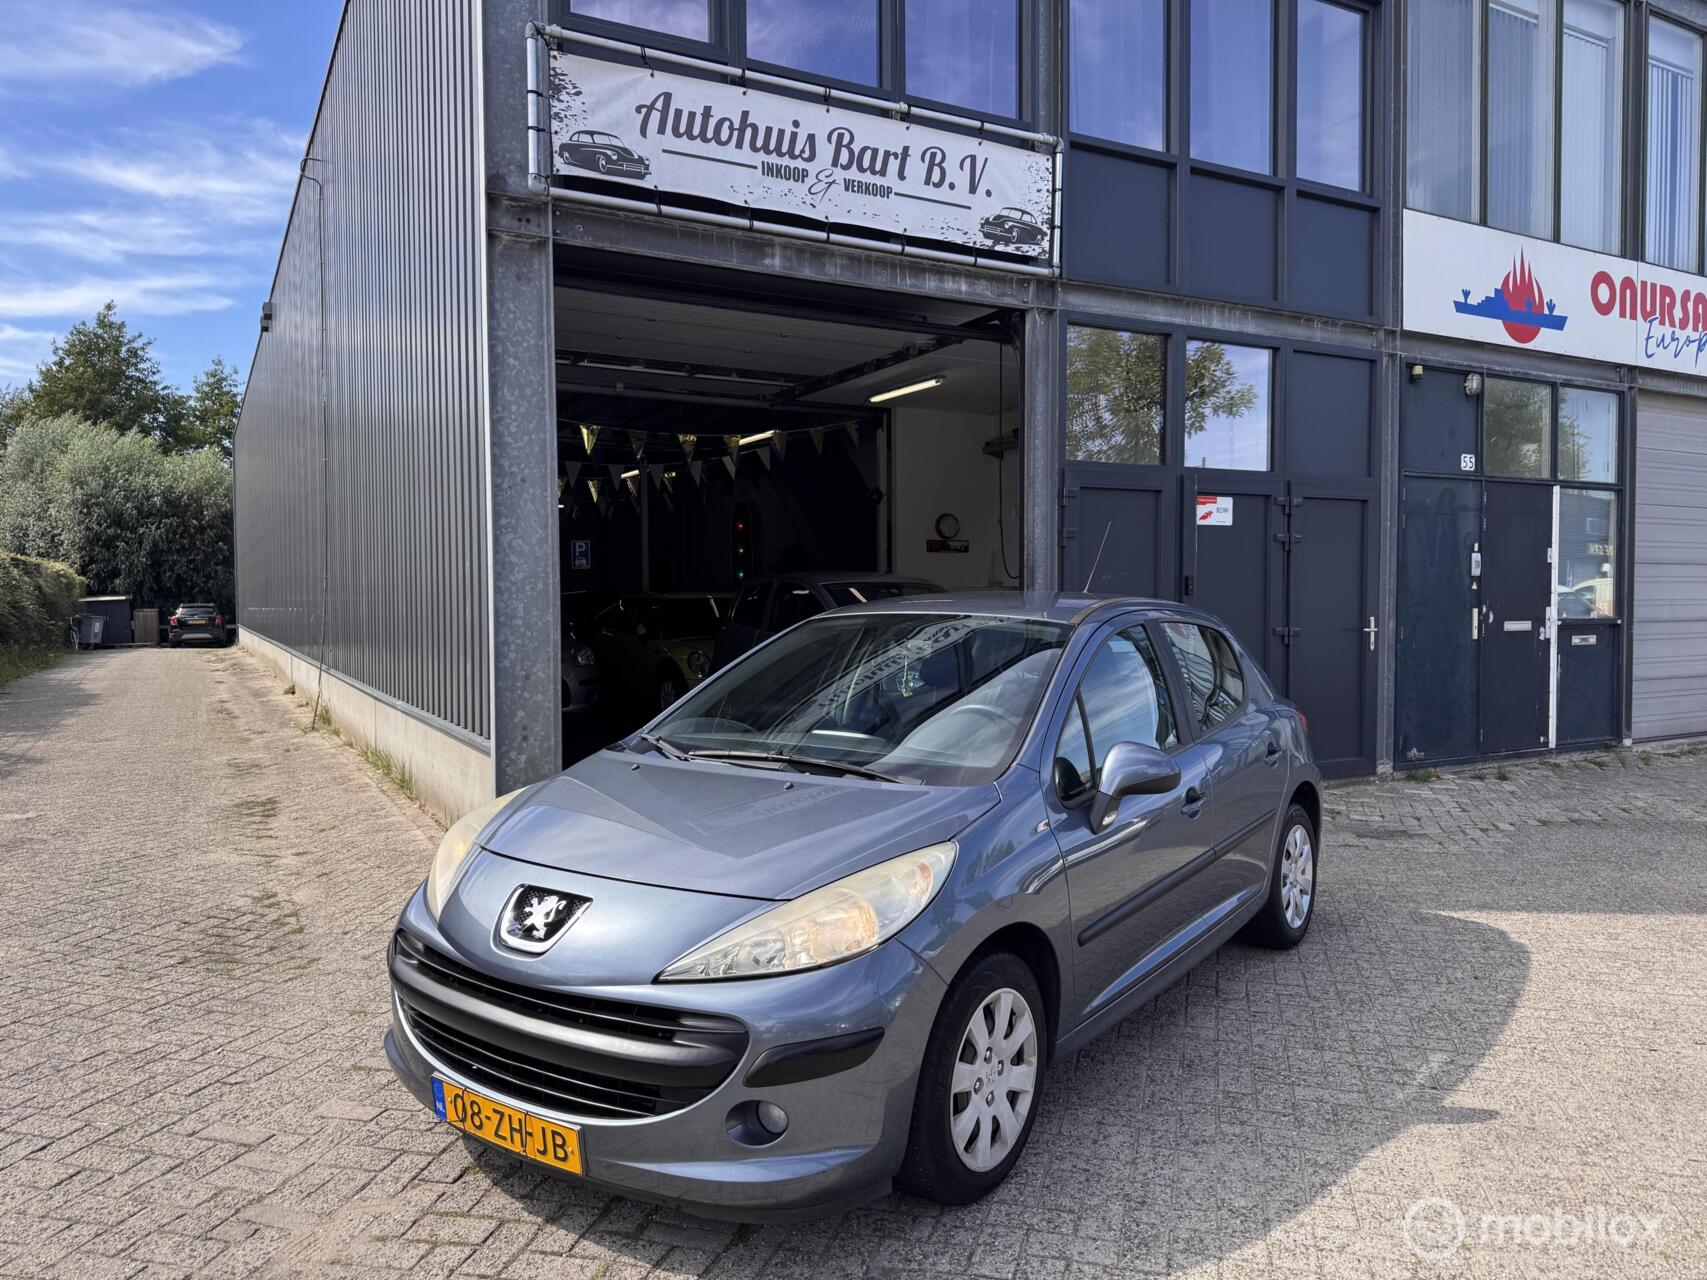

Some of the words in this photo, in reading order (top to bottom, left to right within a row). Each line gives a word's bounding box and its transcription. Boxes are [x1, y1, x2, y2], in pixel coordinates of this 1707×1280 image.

[635, 91, 817, 163] Autohuis
[827, 126, 911, 181] Bart
[920, 146, 993, 197] B.V.
[761, 160, 809, 184] INKOOP
[843, 178, 893, 199] VERKOOP
[1590, 270, 1707, 333] ONURSA
[1463, 456, 1474, 469] 55
[575, 542, 586, 556] P
[436, 1101, 446, 1112] NL
[453, 1092, 569, 1162] 08-ZH-JB
